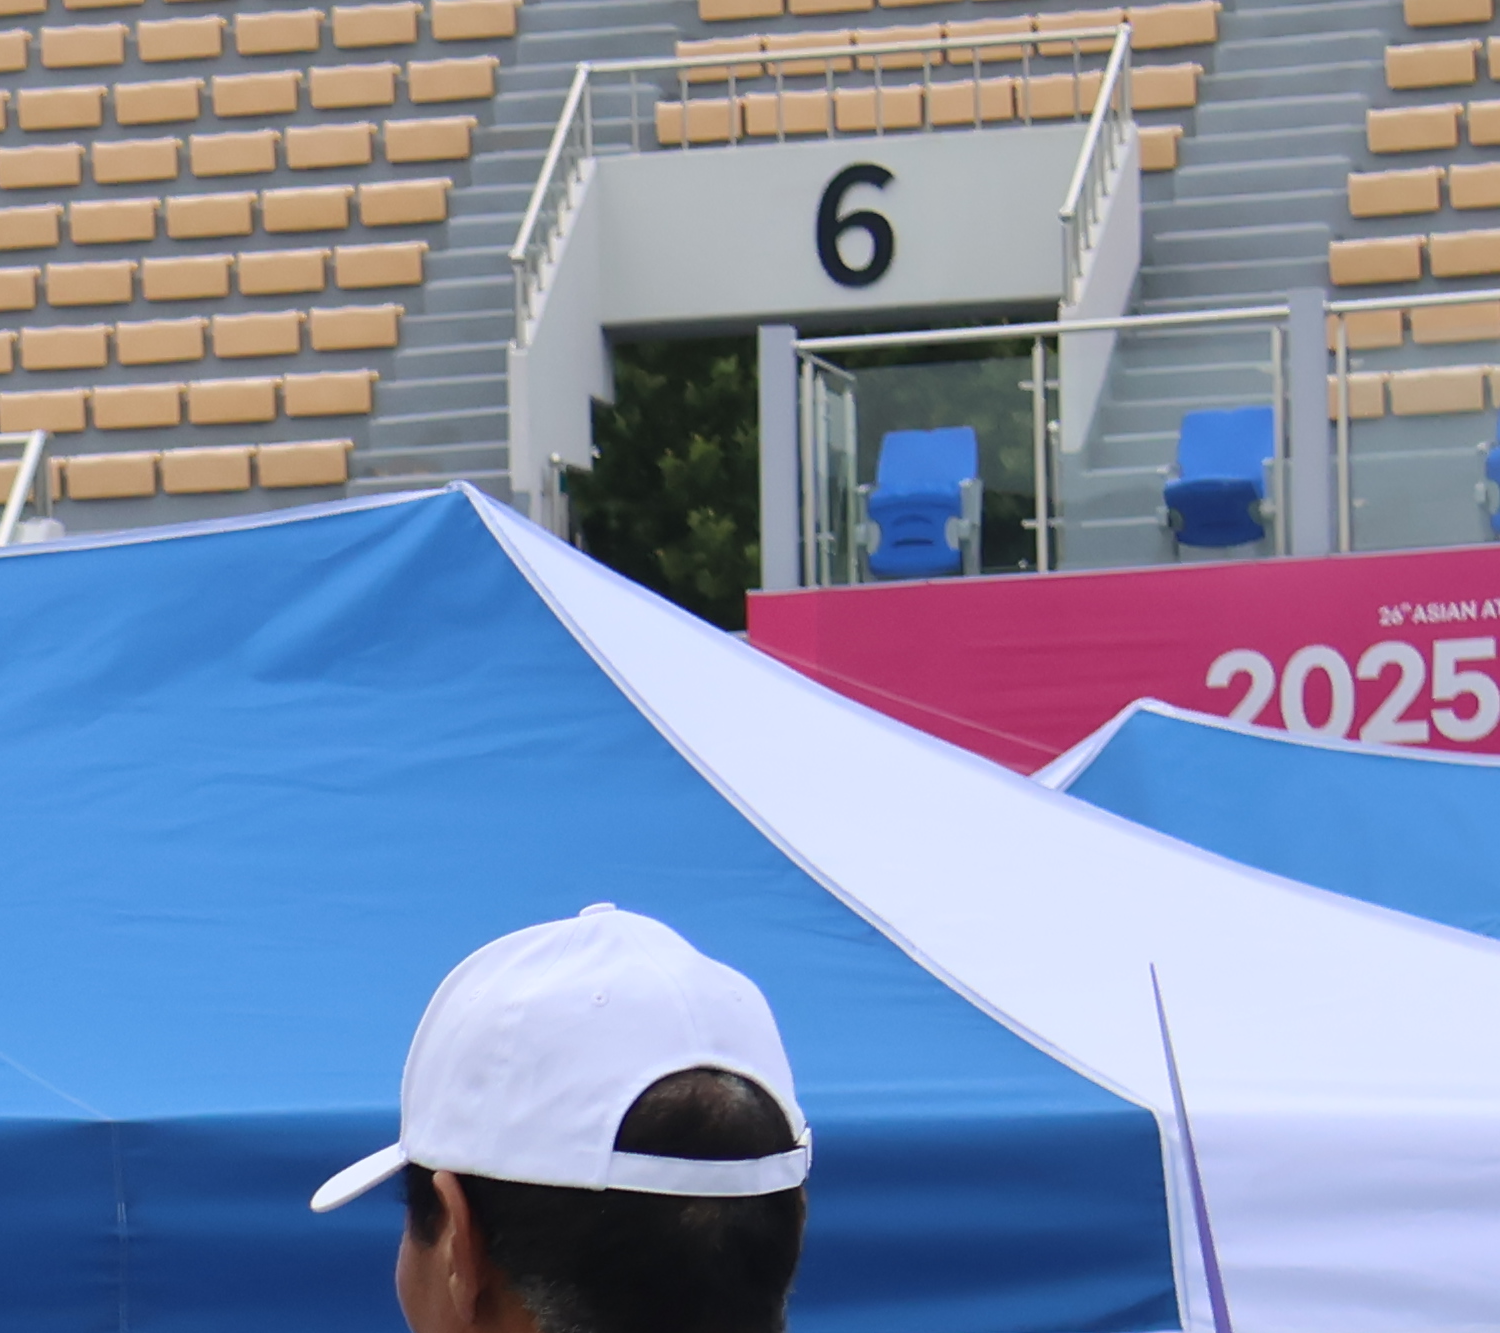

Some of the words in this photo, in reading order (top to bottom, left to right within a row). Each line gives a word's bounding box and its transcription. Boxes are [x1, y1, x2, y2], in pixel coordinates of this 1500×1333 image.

[816, 162, 895, 288] 6
[1411, 599, 1478, 626] ASIAN
[1205, 636, 1500, 744] 2025
